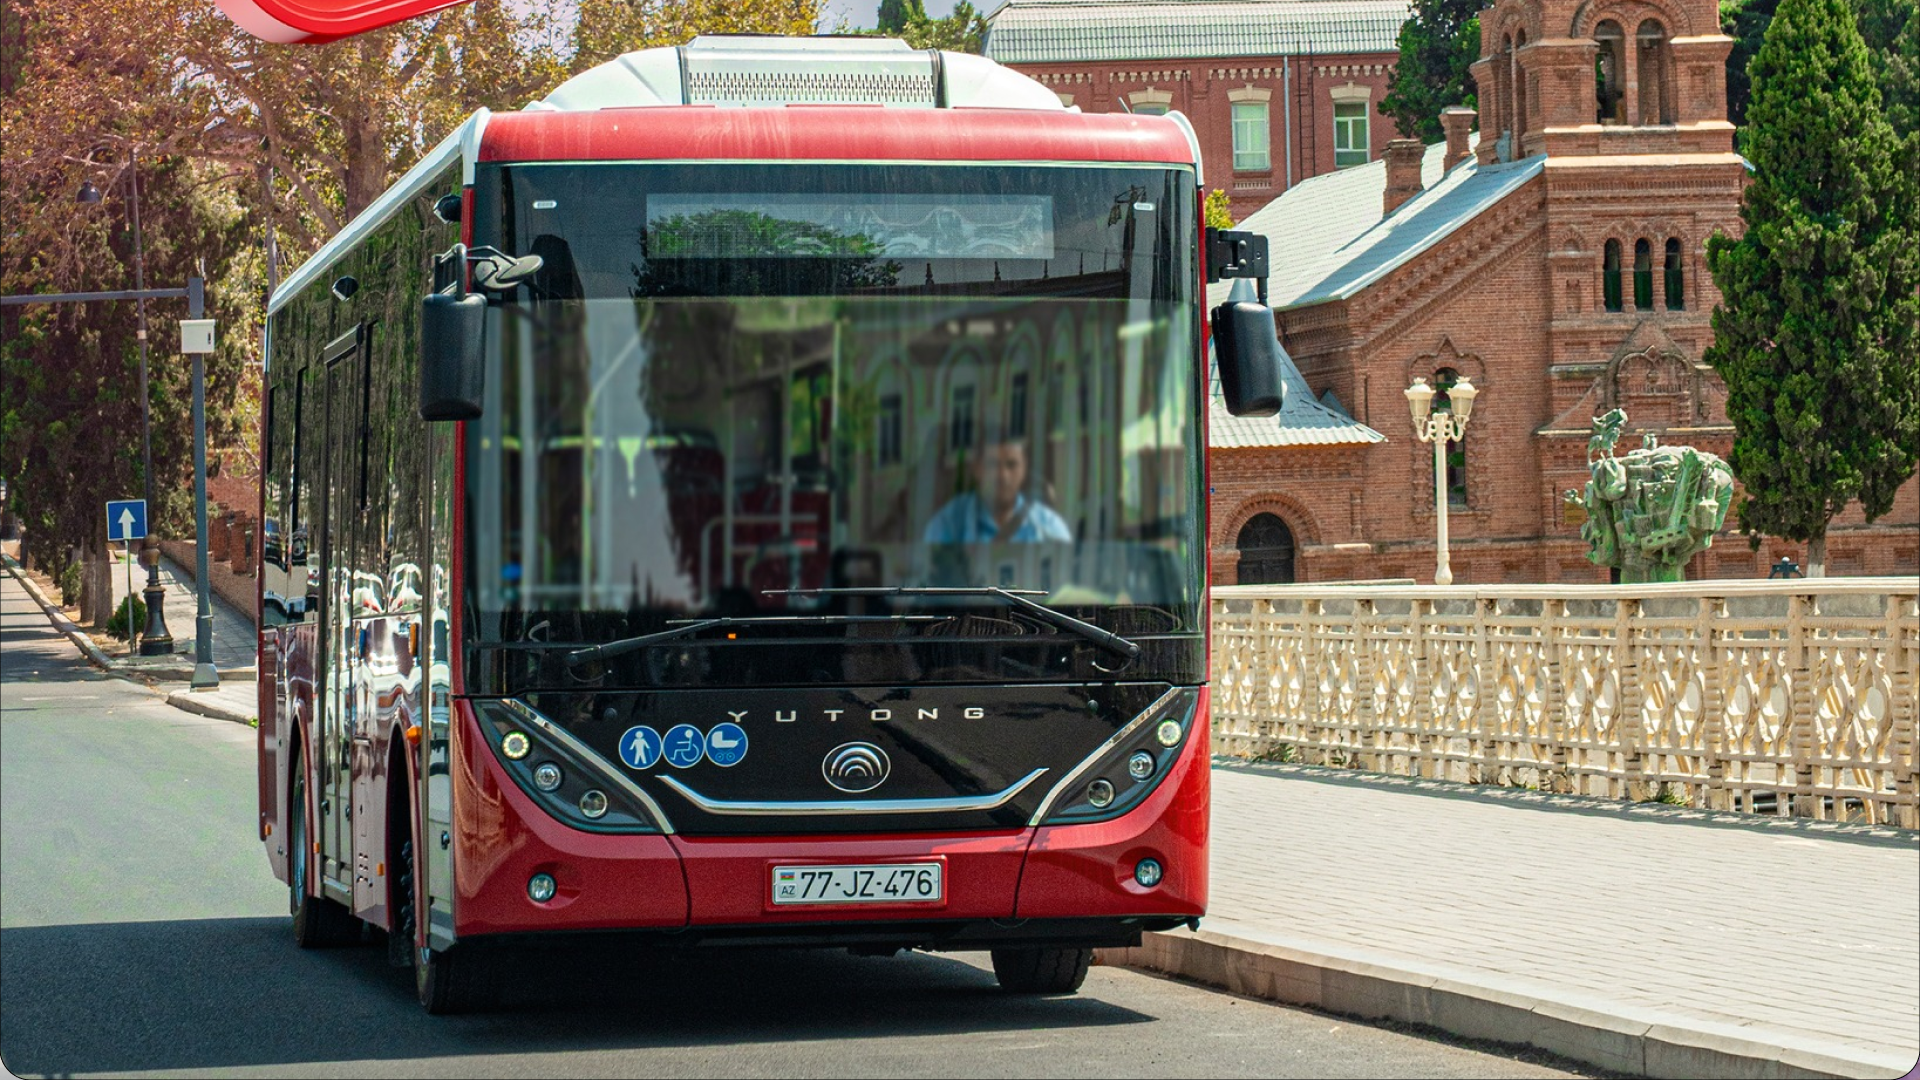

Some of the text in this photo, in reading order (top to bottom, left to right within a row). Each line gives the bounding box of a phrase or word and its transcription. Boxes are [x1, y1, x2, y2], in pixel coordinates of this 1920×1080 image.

[727, 707, 985, 723] YUTONG
[781, 885, 796, 896] AZ
[801, 870, 933, 899] 77-JZ-476
